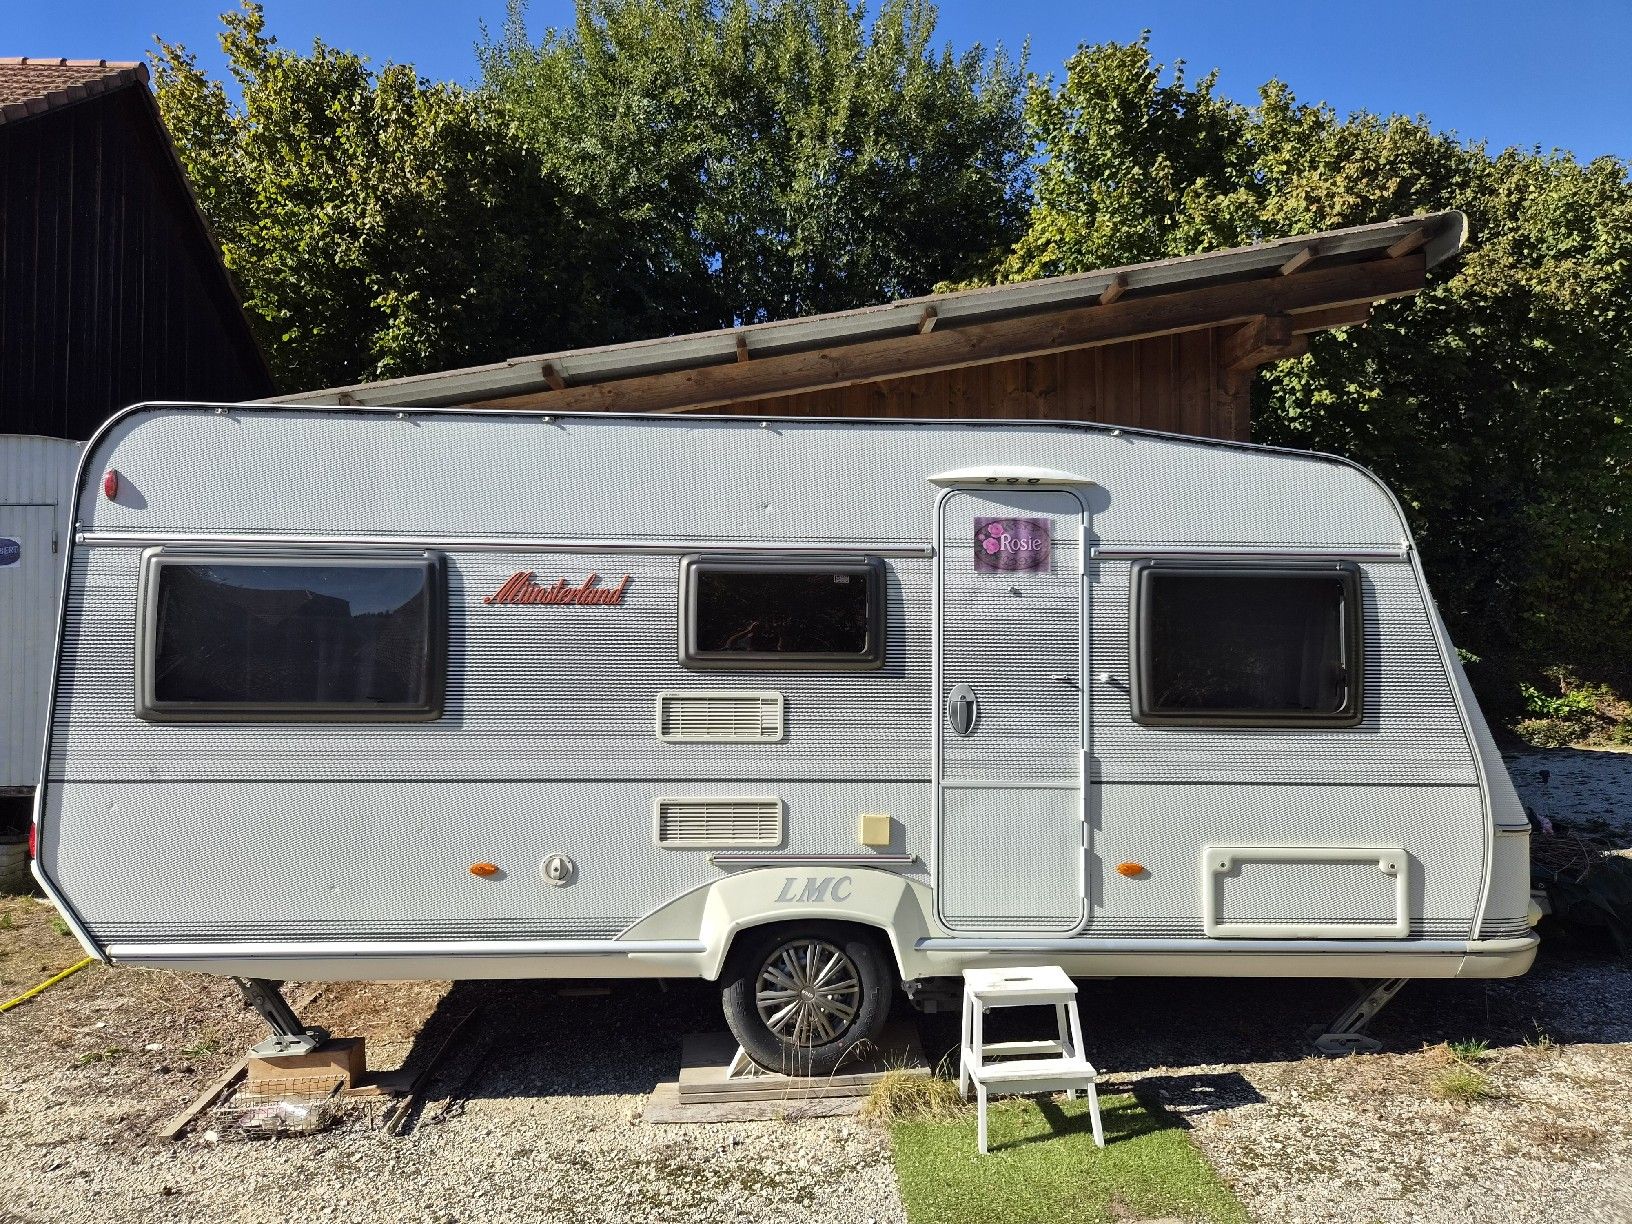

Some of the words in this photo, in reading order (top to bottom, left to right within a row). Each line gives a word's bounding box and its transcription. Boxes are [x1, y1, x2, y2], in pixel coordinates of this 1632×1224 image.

[1000, 533, 1042, 554] Rosie
[483, 569, 631, 605] Münsterland
[774, 875, 852, 903] LMC
